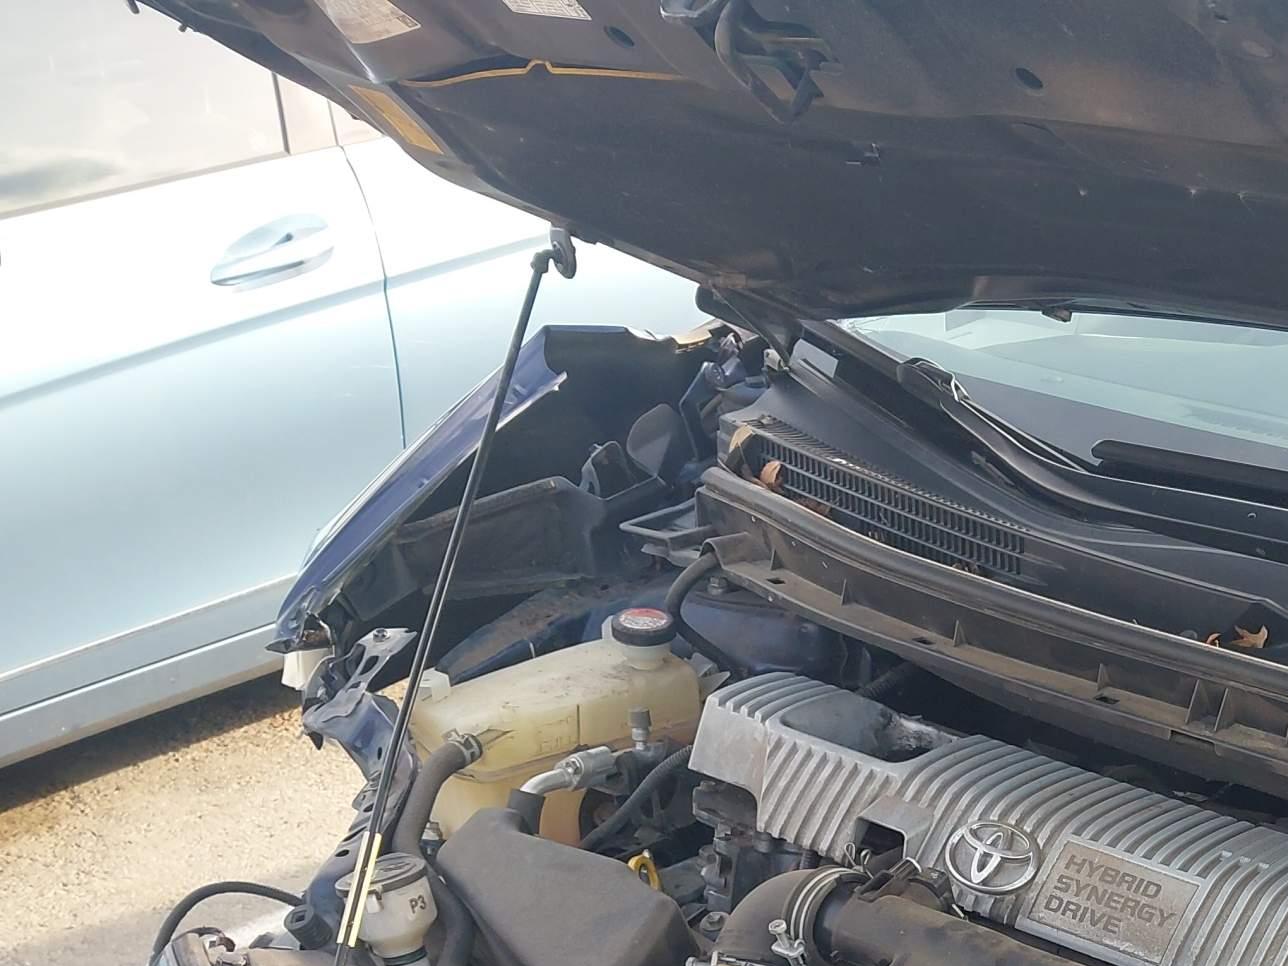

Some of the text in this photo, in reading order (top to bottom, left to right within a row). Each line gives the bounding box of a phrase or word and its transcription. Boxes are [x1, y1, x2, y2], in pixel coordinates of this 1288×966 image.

[1064, 854, 1162, 899] HYBRID
[408, 894, 427, 914] P3
[1043, 893, 1122, 935] DRIVE
[1053, 873, 1176, 928] SYNERGY
